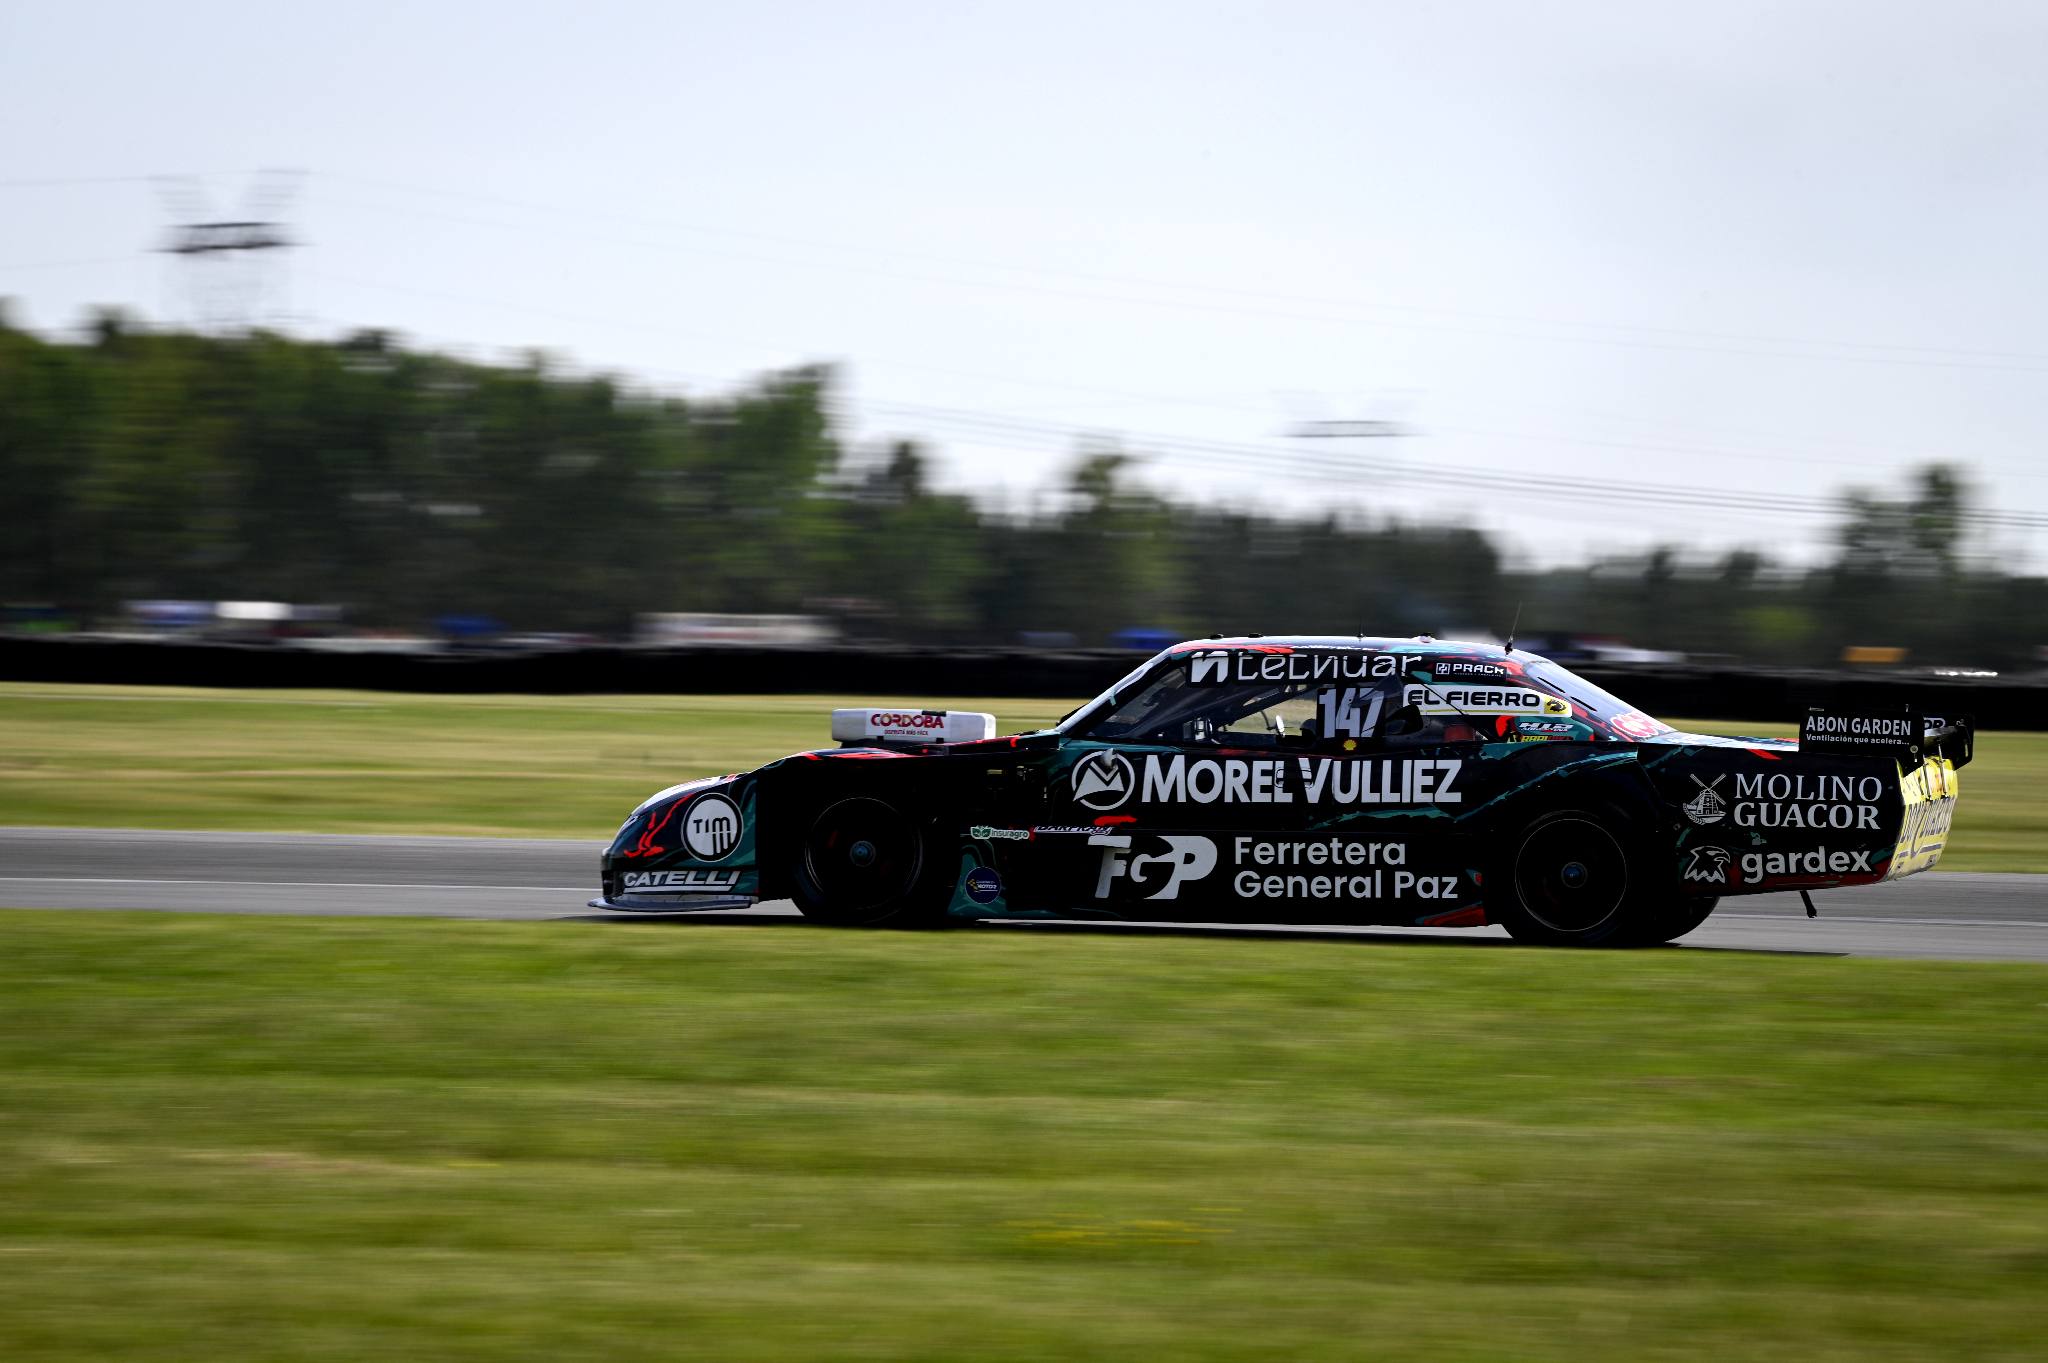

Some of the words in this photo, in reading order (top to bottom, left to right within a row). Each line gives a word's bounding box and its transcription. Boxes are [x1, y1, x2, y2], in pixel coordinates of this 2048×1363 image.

[1407, 689, 1441, 706] EL
[1446, 691, 1541, 707] FIERRO
[1319, 687, 1385, 739] 147
[1806, 715, 1848, 733] ABON
[1851, 717, 1911, 736] GARDEN
[1806, 733, 1852, 743] Ventilación
[1141, 754, 1293, 803] MOREL
[1298, 757, 1462, 803] VULLIEZ
[1733, 773, 1883, 802] MOLINO
[1733, 801, 1881, 830] GUACOR
[1234, 837, 1406, 865] Ferretera
[1741, 845, 1872, 884] gardex
[624, 870, 741, 887] CATELLI
[1233, 869, 1382, 899] General
[1394, 871, 1458, 899] Paz
